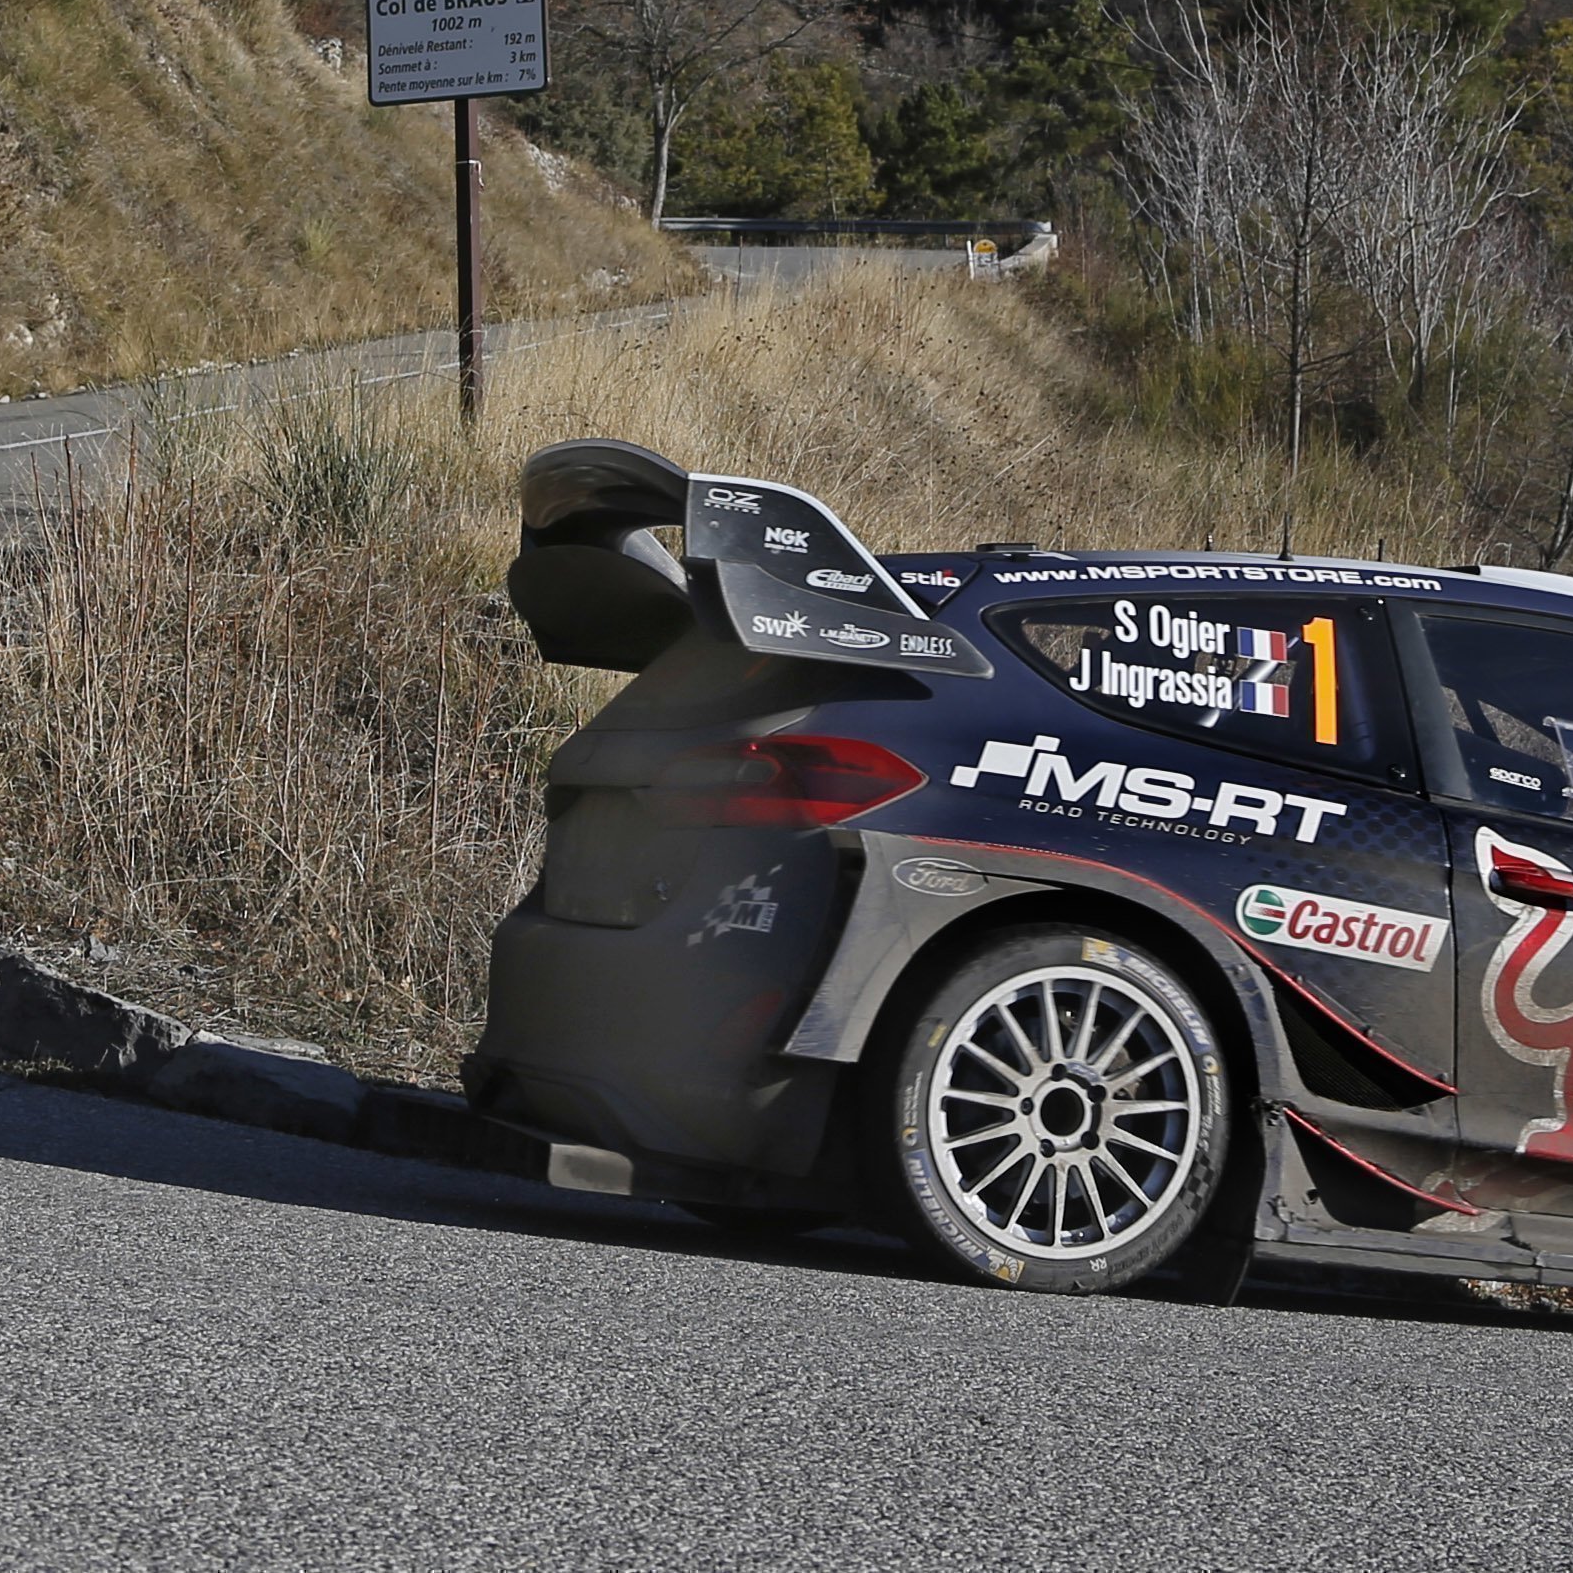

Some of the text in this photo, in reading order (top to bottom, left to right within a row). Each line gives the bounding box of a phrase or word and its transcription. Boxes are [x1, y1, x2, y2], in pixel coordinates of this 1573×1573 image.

[431, 16, 482, 32] 1002 m
[378, 42, 424, 57] Dénivelé
[427, 38, 467, 52] Restant
[503, 32, 535, 46] 192 m
[378, 61, 422, 76] Sommet
[510, 49, 536, 64] 3 km
[378, 80, 407, 94] Pente
[409, 76, 455, 93] moyenne
[457, 75, 473, 86] sur
[475, 72, 485, 85] le
[487, 71, 503, 84] km
[764, 526, 810, 547] NGK
[993, 565, 1442, 591] www.MSPORTSTORE.com
[752, 615, 799, 639] SWP
[1113, 600, 1231, 659] S Ogier
[1069, 648, 1233, 709] J Ingrassia
[1302, 617, 1338, 745] 1
[1018, 799, 1253, 846] ROAD TECHNOLOGY
[1288, 899, 1432, 962] Castrol
[1125, 956, 1209, 1047] MICHELIN
[907, 1158, 982, 1260] MICHELIN
